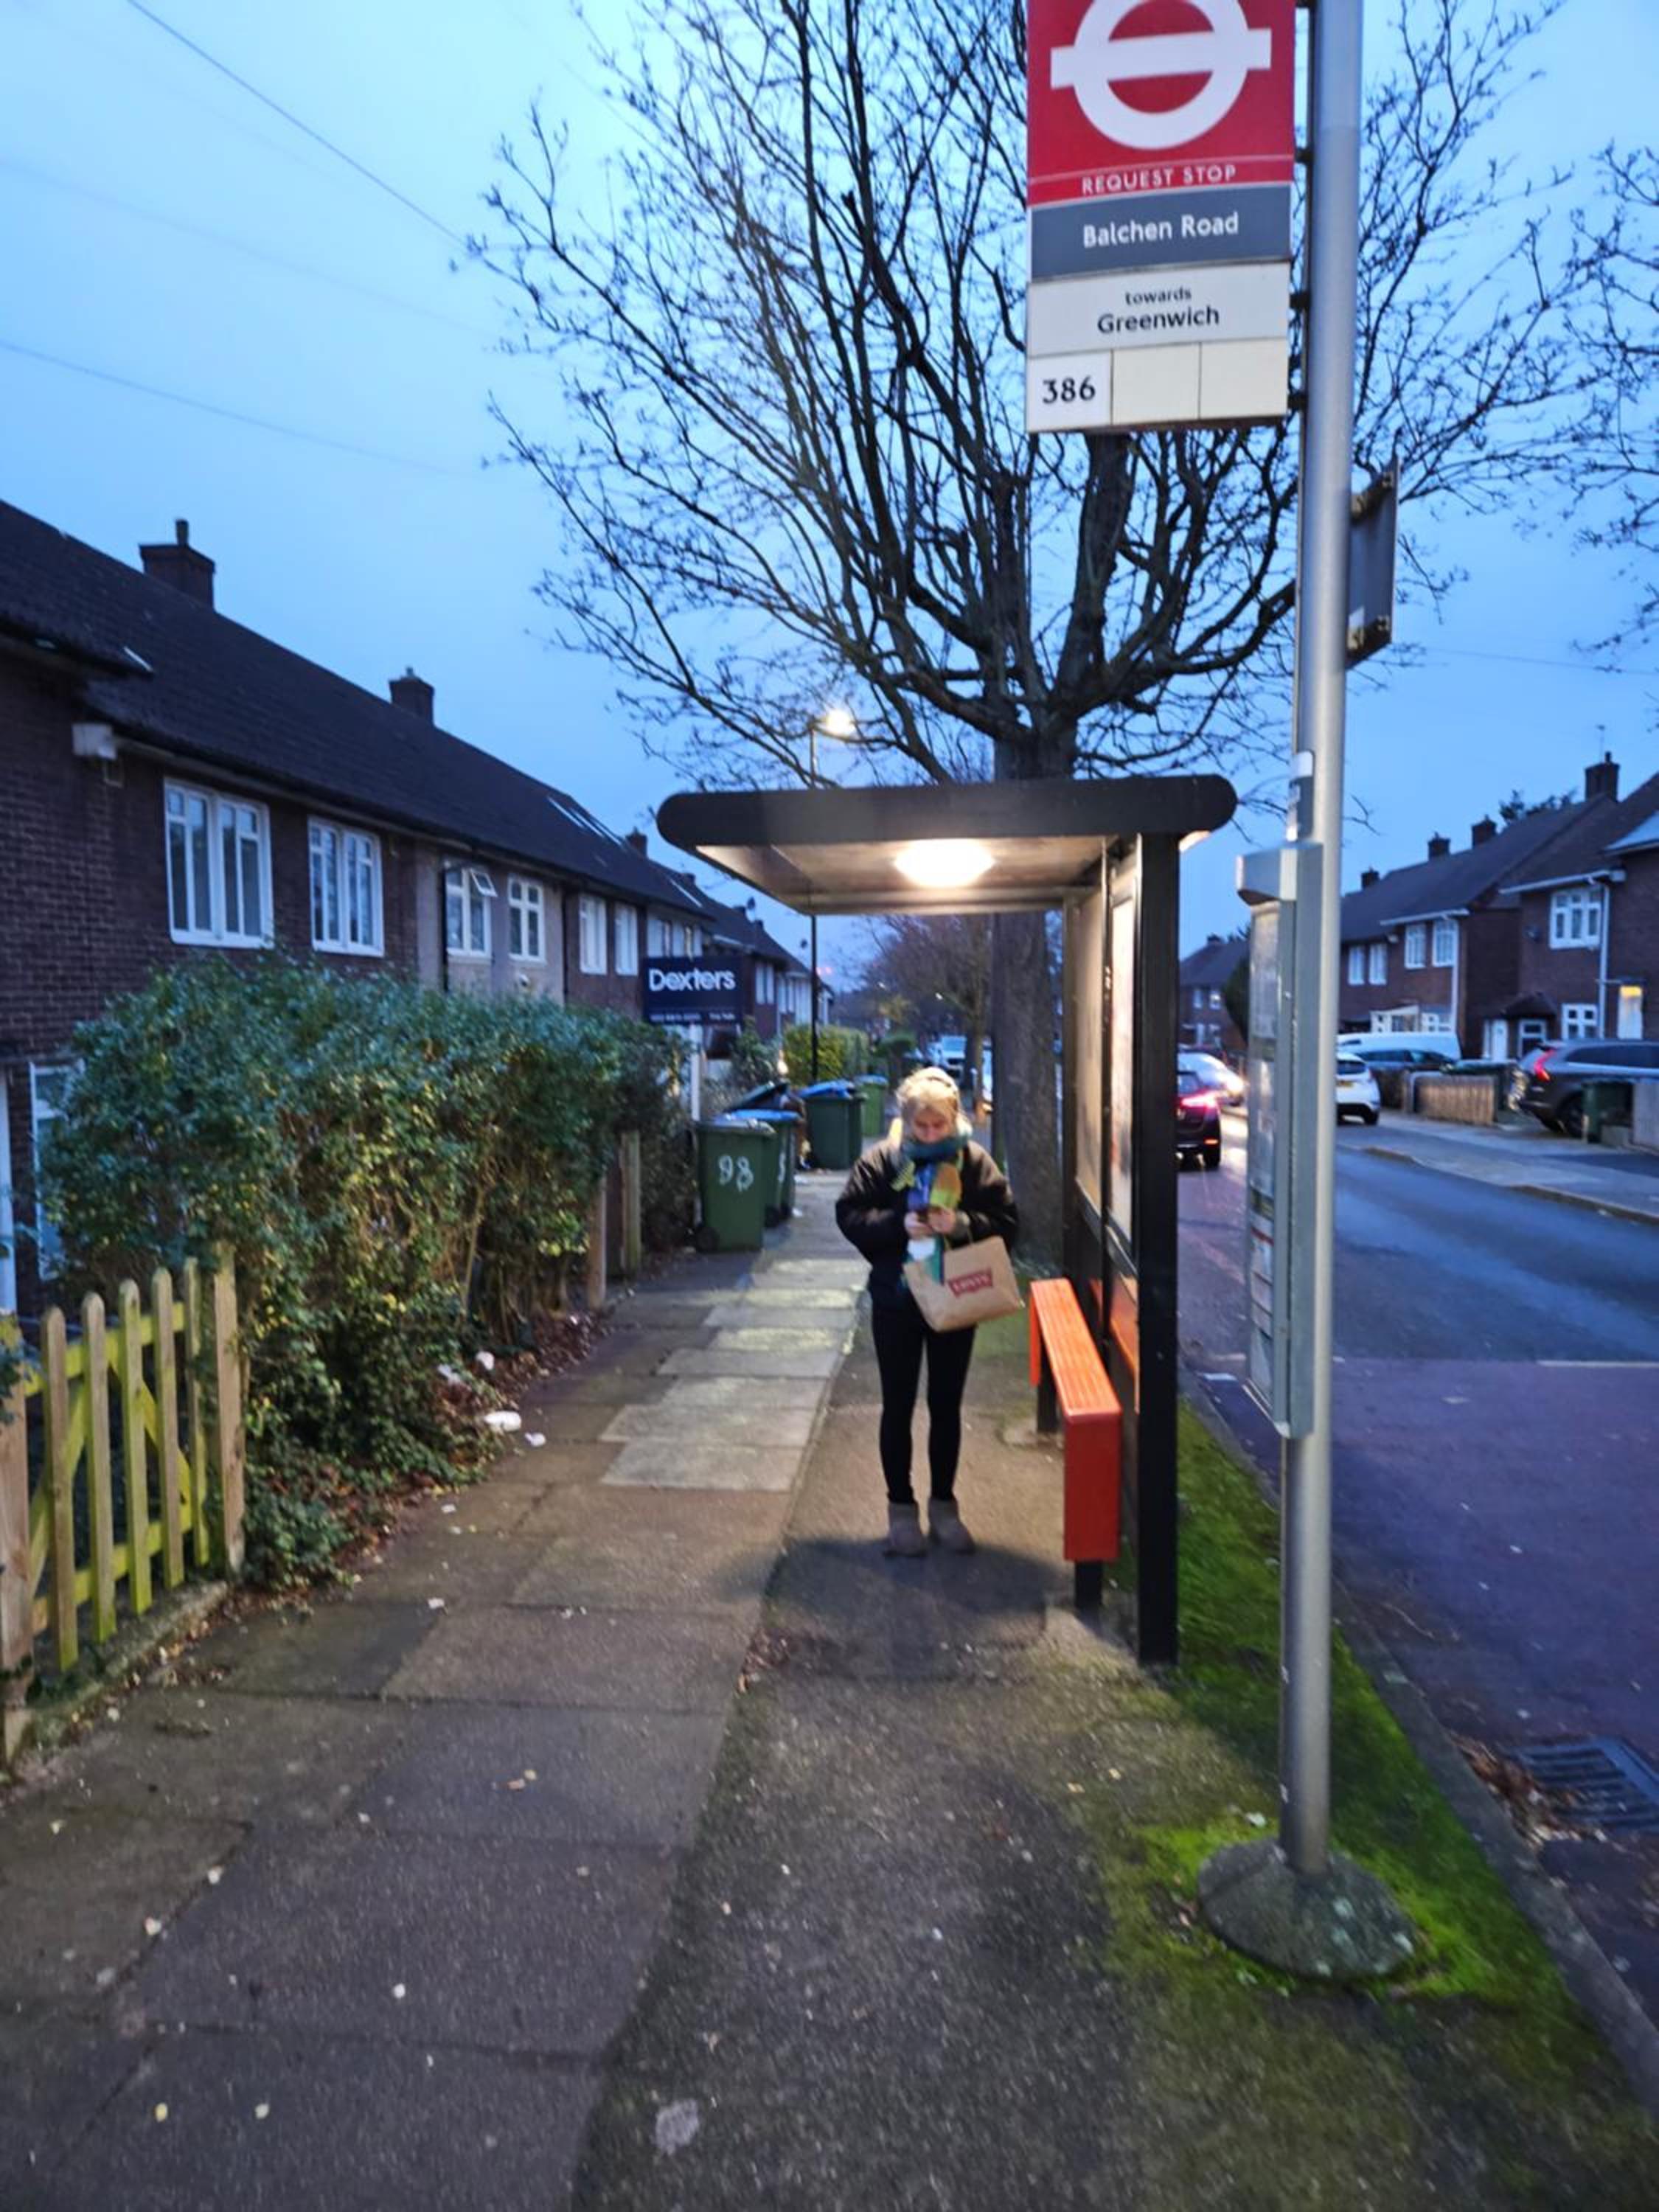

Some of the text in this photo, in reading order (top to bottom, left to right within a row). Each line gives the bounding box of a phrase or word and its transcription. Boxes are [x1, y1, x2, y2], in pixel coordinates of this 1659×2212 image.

[1082, 164, 1237, 195] REQUEST STOP
[1083, 211, 1239, 248] Balchen Road
[1125, 286, 1192, 305] towards
[1097, 305, 1220, 334] Greenwich
[1043, 375, 1096, 404] 386
[649, 967, 736, 991] Dexters
